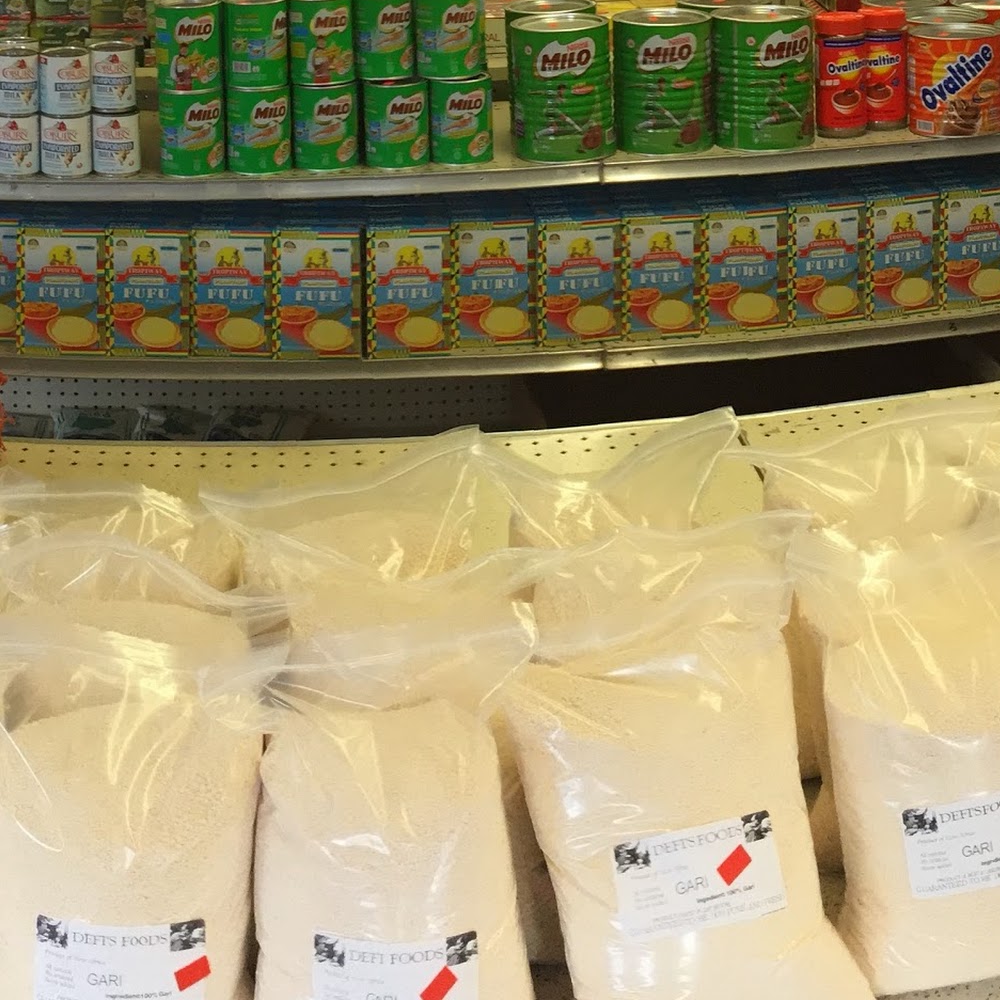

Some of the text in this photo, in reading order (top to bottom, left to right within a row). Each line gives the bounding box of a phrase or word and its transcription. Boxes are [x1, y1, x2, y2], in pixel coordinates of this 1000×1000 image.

[314, 15, 348, 29] MILO
[381, 11, 411, 25] MILO
[445, 11, 475, 25] MILO
[178, 23, 212, 36] MILO
[642, 43, 693, 65] MILO
[765, 36, 809, 60] MILO
[541, 48, 591, 71] MILO
[828, 58, 864, 75] Ovaltin
[868, 54, 901, 67] valtine
[921, 44, 994, 111] Ovaltine
[317, 103, 350, 116] MILO
[390, 101, 423, 115] MILO
[448, 98, 483, 111] MILO
[188, 108, 219, 121] MILO
[254, 105, 286, 119] MILO
[0, 143, 31, 152] VAPORATED
[805, 257, 848, 271] FUFU
[884, 250, 925, 264] FUFU
[639, 271, 684, 284] FUFU
[720, 264, 769, 278] FUFU
[471, 278, 519, 291] FUFU
[559, 278, 603, 290] FUFU
[38, 287, 85, 298] FUFU
[123, 287, 170, 299] FUFU
[207, 288, 254, 300] FUFU
[295, 290, 343, 301] FUFU
[387, 287, 433, 299] FUFU
[698, 825, 743, 845] FOODS
[961, 841, 994, 858] GARI
[675, 876, 709, 895] GARI
[121, 933, 168, 947] FOODS
[390, 949, 444, 965] FOODS
[87, 973, 122, 986] GARI
